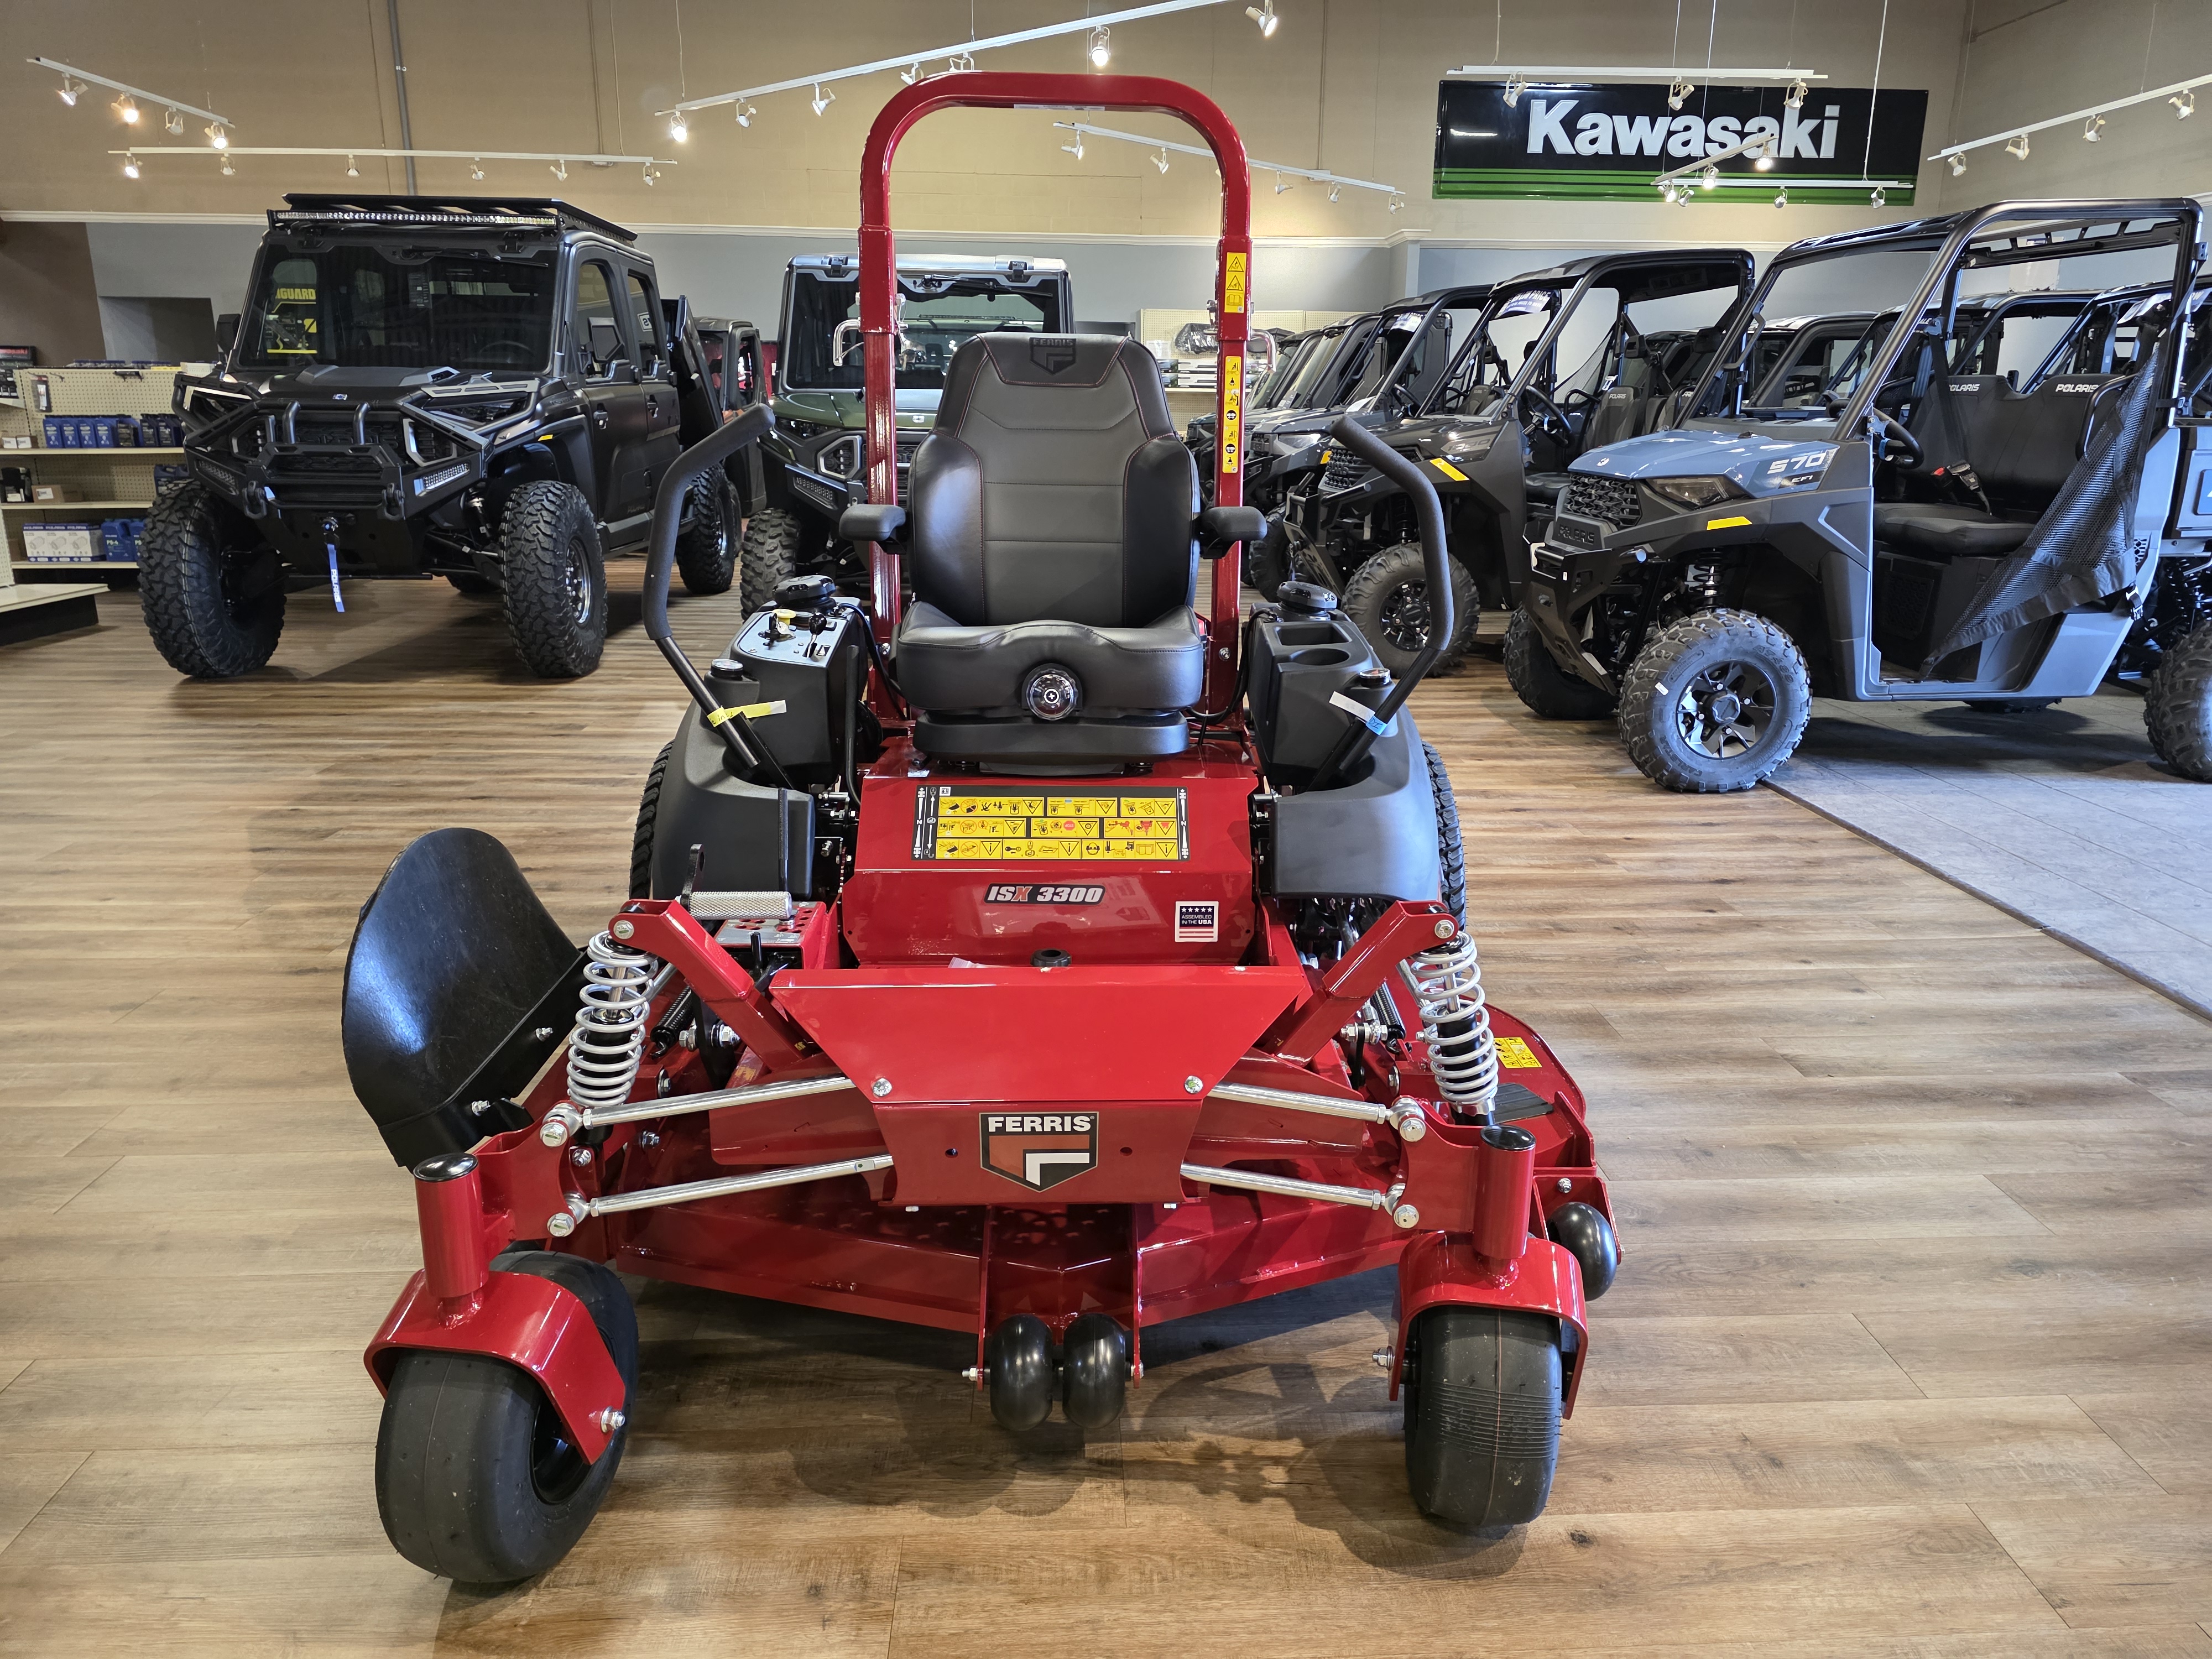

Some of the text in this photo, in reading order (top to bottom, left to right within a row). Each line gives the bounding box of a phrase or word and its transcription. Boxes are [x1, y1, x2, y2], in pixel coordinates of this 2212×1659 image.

[1527, 99, 1840, 159] Kawasaki
[2056, 384, 2099, 393] POLARIS
[1767, 452, 1827, 474] 570
[1791, 475, 1813, 483] EFI
[1558, 524, 1595, 545] POLARIS
[331, 568, 341, 603] POLARIS
[987, 886, 1103, 902] ISX 3300
[988, 1115, 1092, 1132] FERRIS
